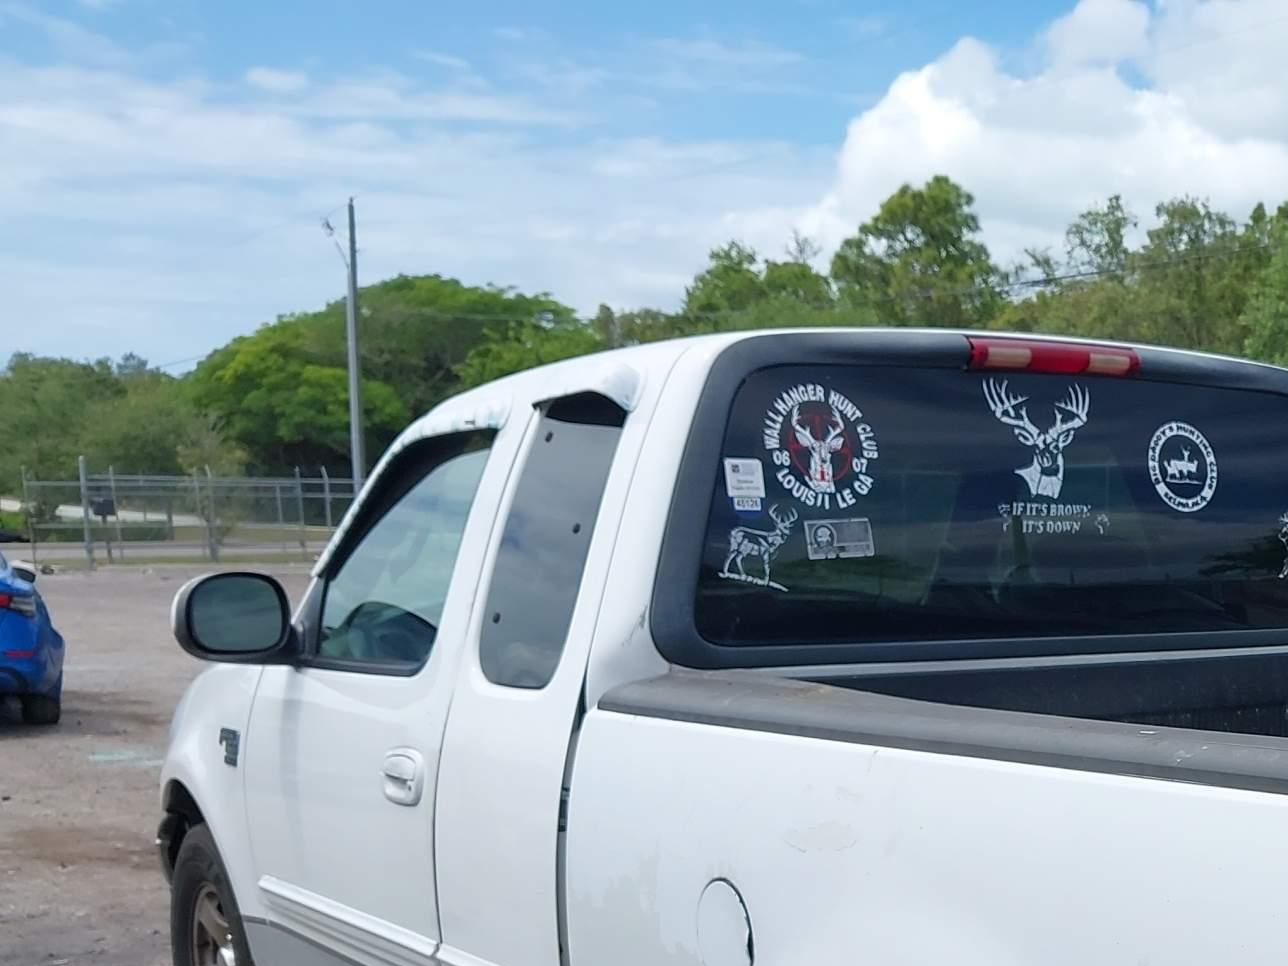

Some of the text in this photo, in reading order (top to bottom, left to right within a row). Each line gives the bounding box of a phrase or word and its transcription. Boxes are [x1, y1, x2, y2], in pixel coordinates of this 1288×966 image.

[763, 384, 879, 460] WALL HANGER HUNT CLUB
[772, 449, 791, 466] 06
[852, 458, 868, 474] 07
[853, 474, 874, 495] GA
[1012, 501, 1091, 518] IF IT'S BROWN
[1022, 519, 1081, 534] IT'S DOWN
